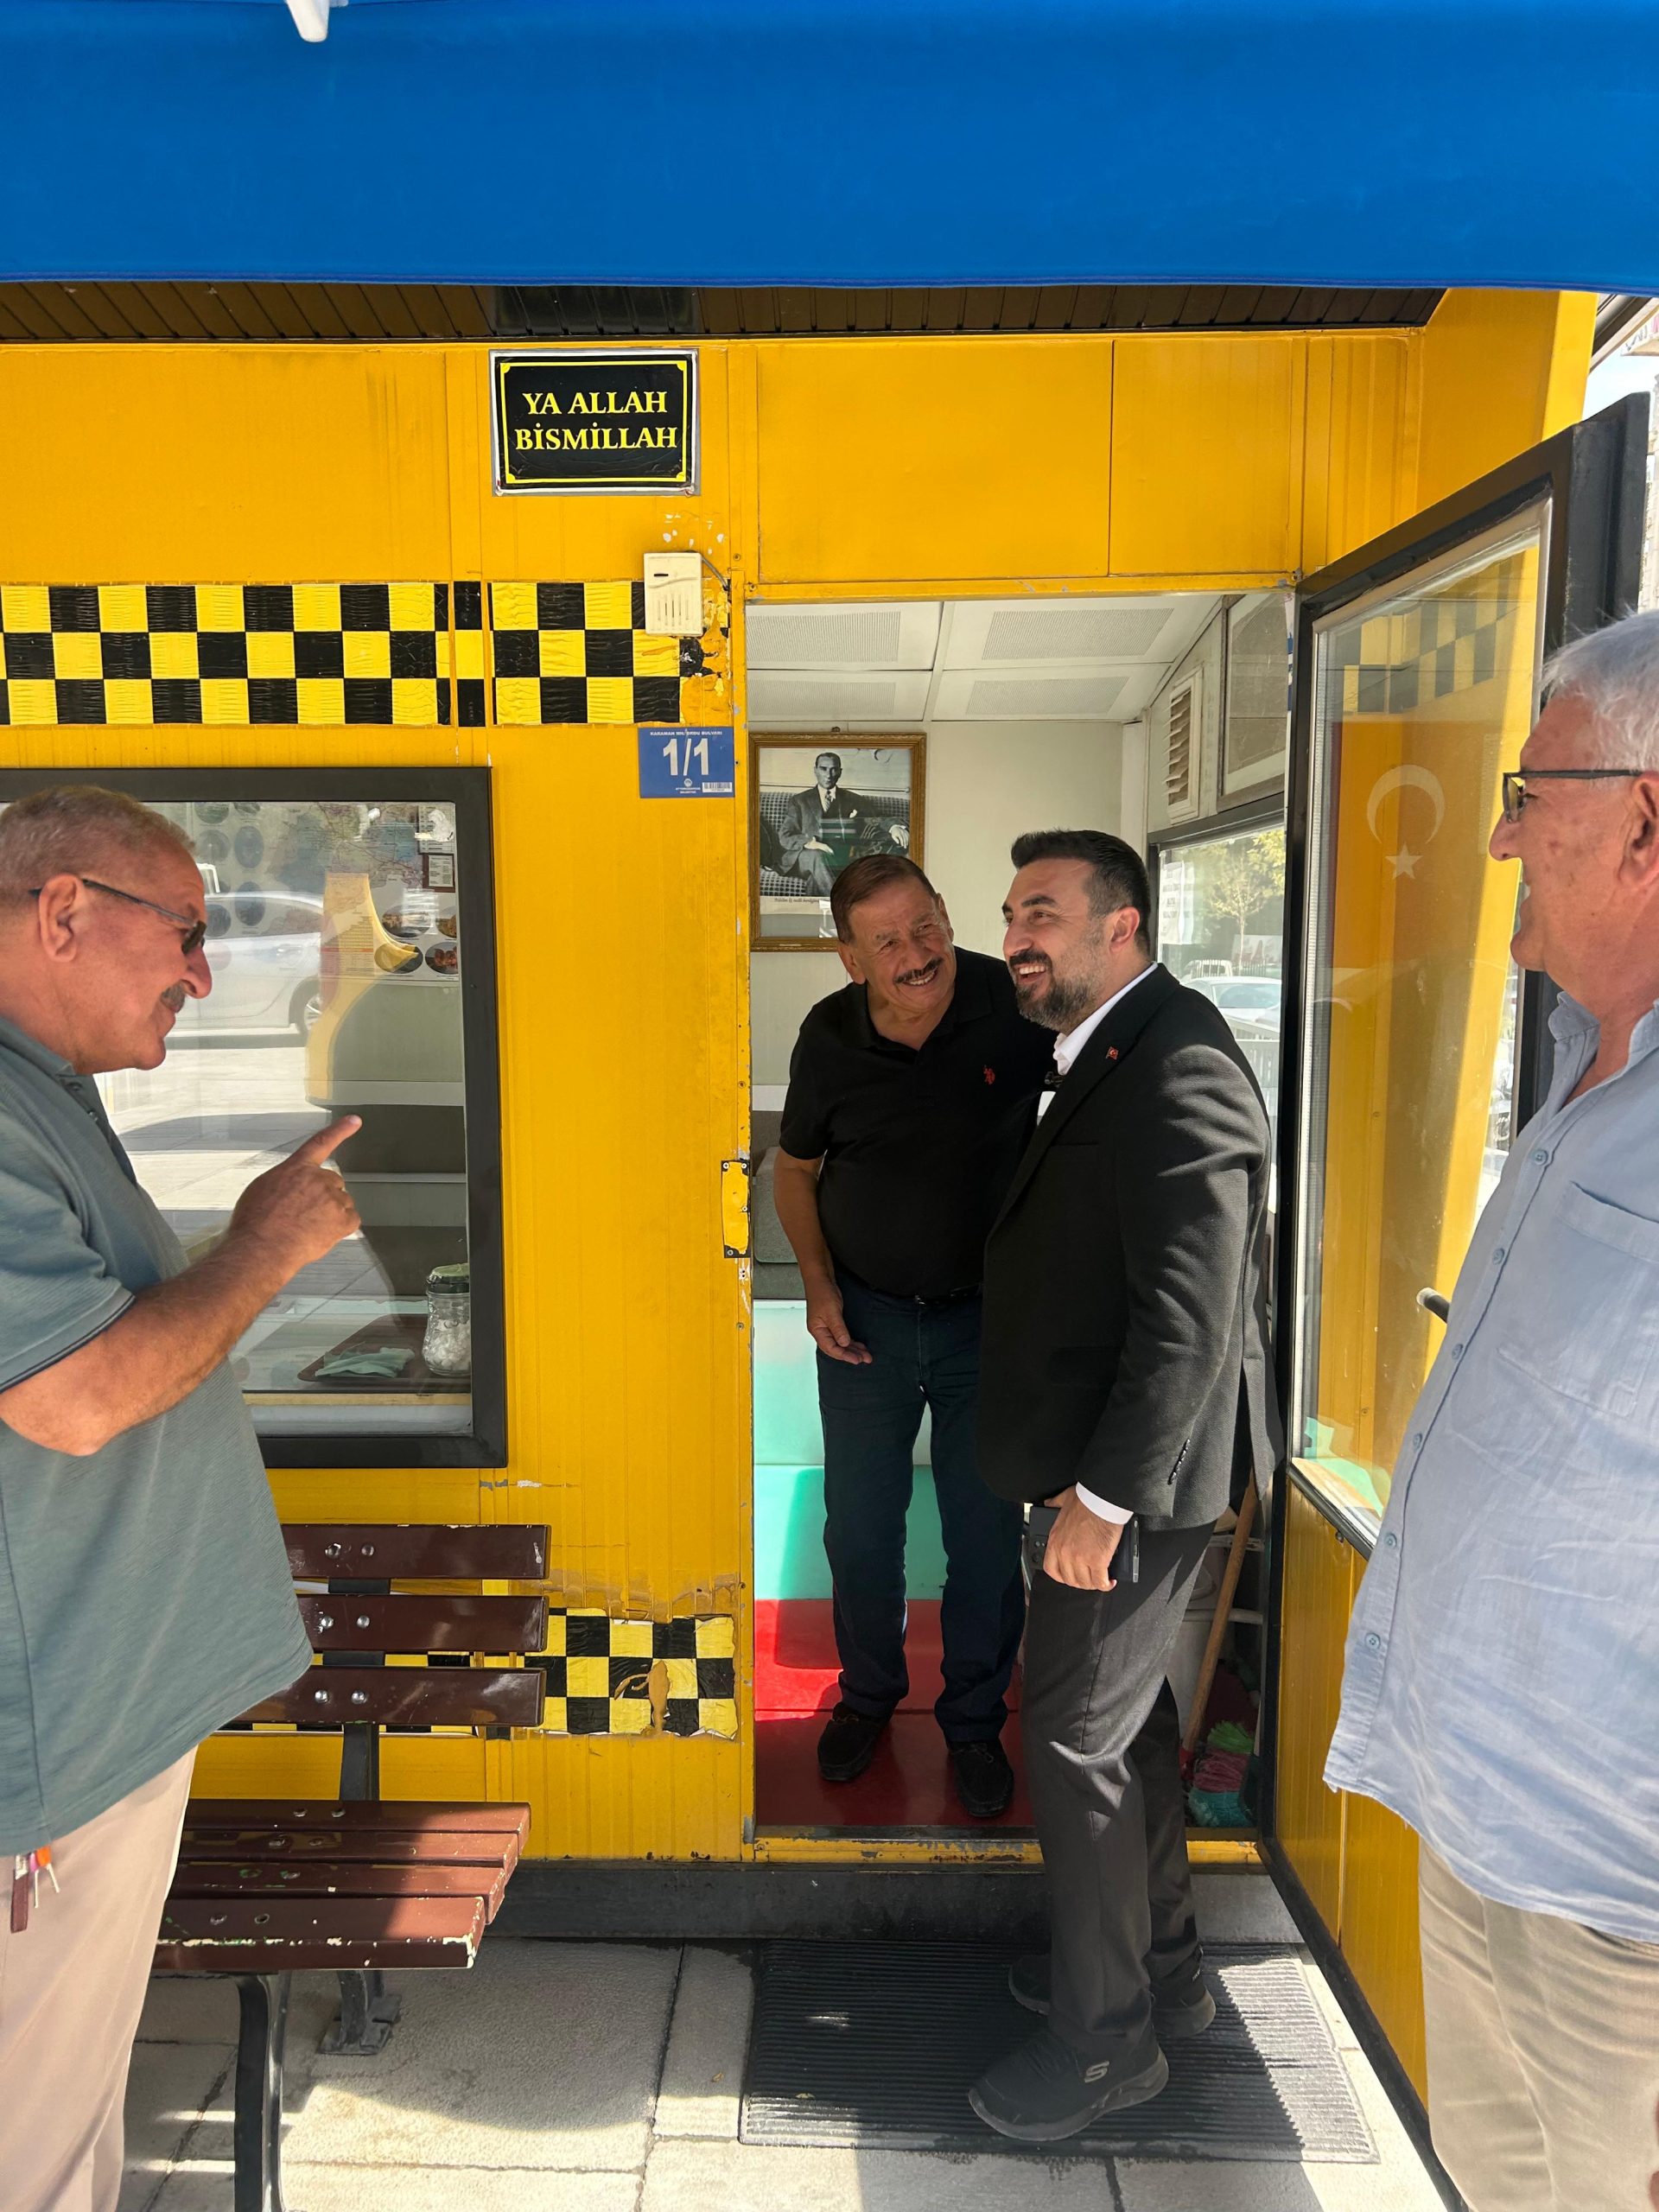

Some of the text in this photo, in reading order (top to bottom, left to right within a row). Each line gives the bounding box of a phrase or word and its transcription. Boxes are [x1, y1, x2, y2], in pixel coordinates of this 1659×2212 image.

[522, 391, 668, 415] YA ALLAH
[514, 422, 678, 450] BİSMİLLAH
[663, 738, 709, 776] 1/1
